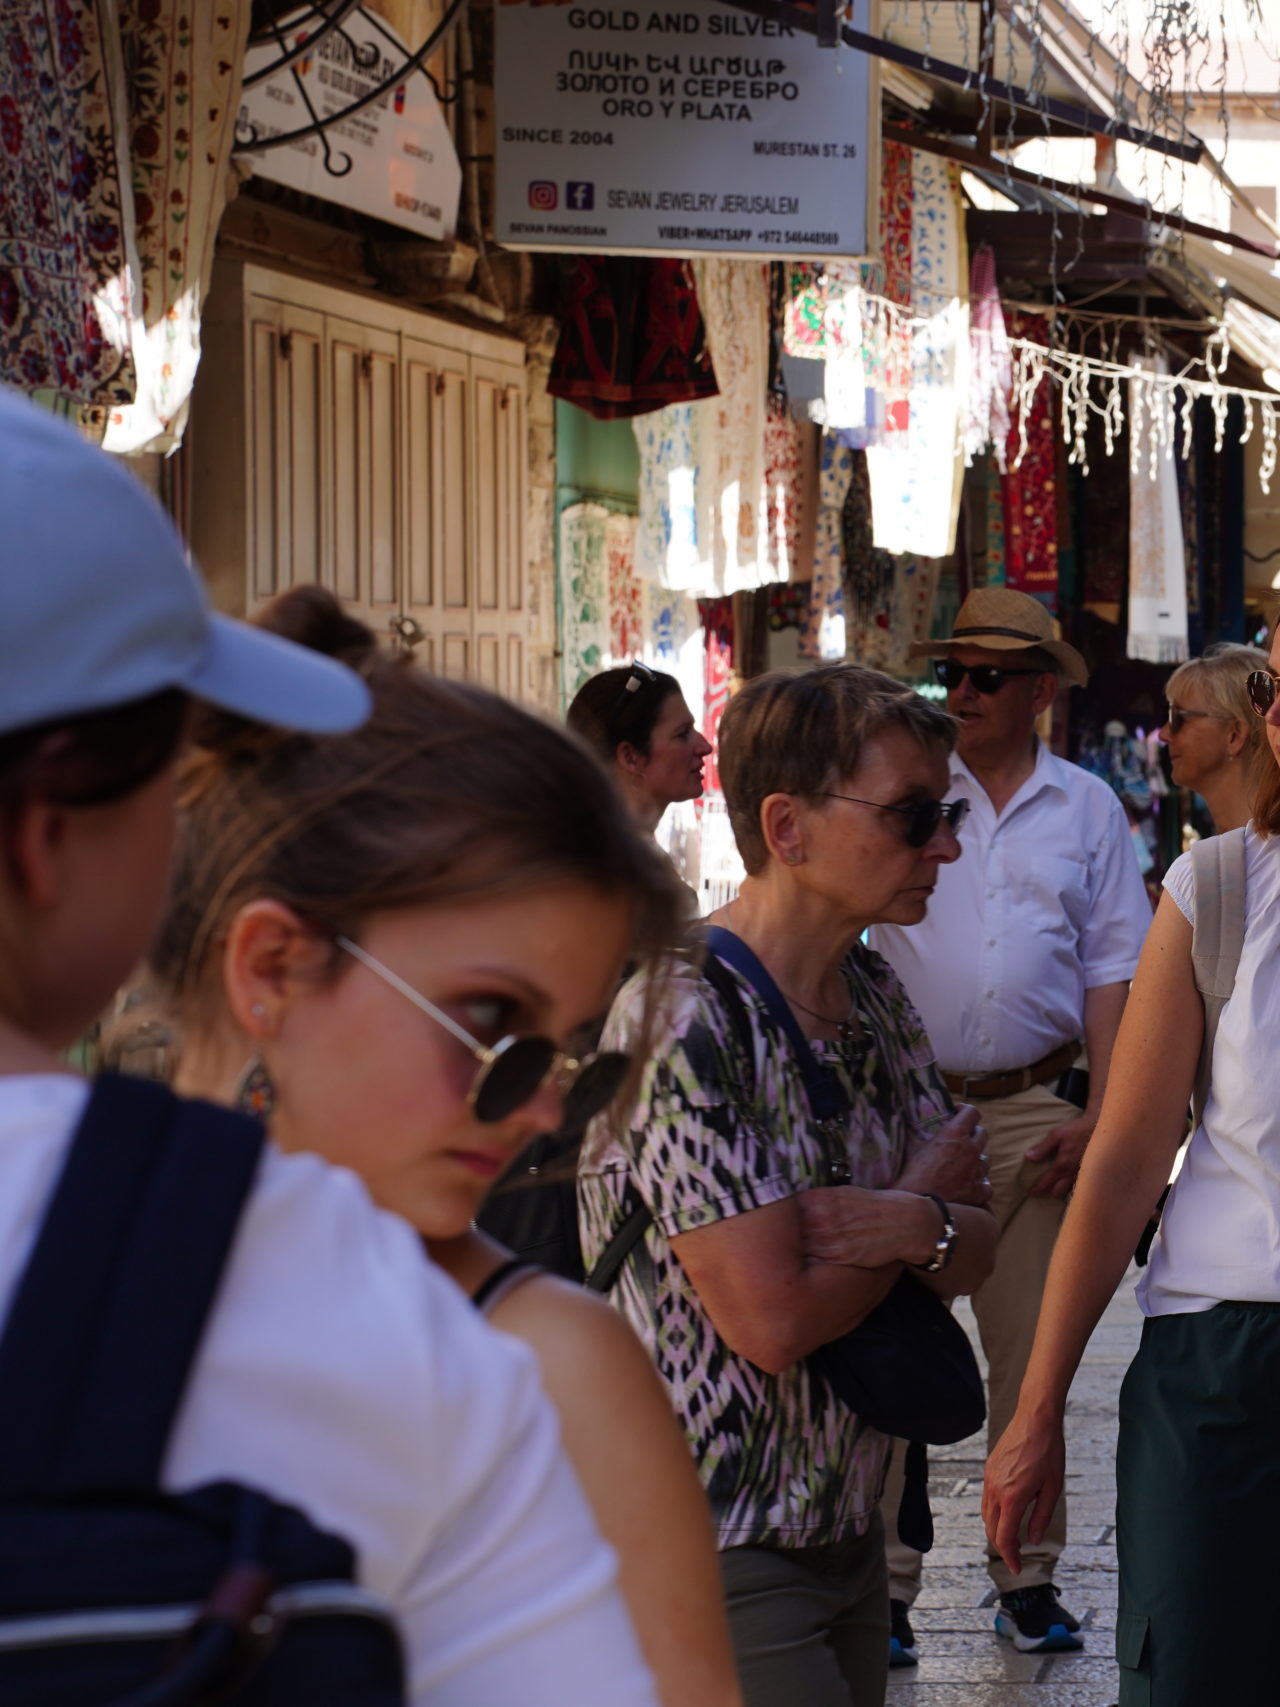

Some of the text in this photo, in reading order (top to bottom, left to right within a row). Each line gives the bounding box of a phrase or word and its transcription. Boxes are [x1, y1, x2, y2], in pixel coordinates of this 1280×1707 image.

[568, 9, 796, 38] GOLD AND SILVER
[556, 72, 799, 101] ЗОЛОТО И СЕРЕБРО
[602, 99, 752, 121] ORO Y PLATA
[502, 128, 614, 146] SINCE 2004
[753, 141, 819, 157] MURESTAN
[823, 143, 840, 158] ST.
[607, 189, 800, 215] SEVAN JEWELRY JERUSALEM
